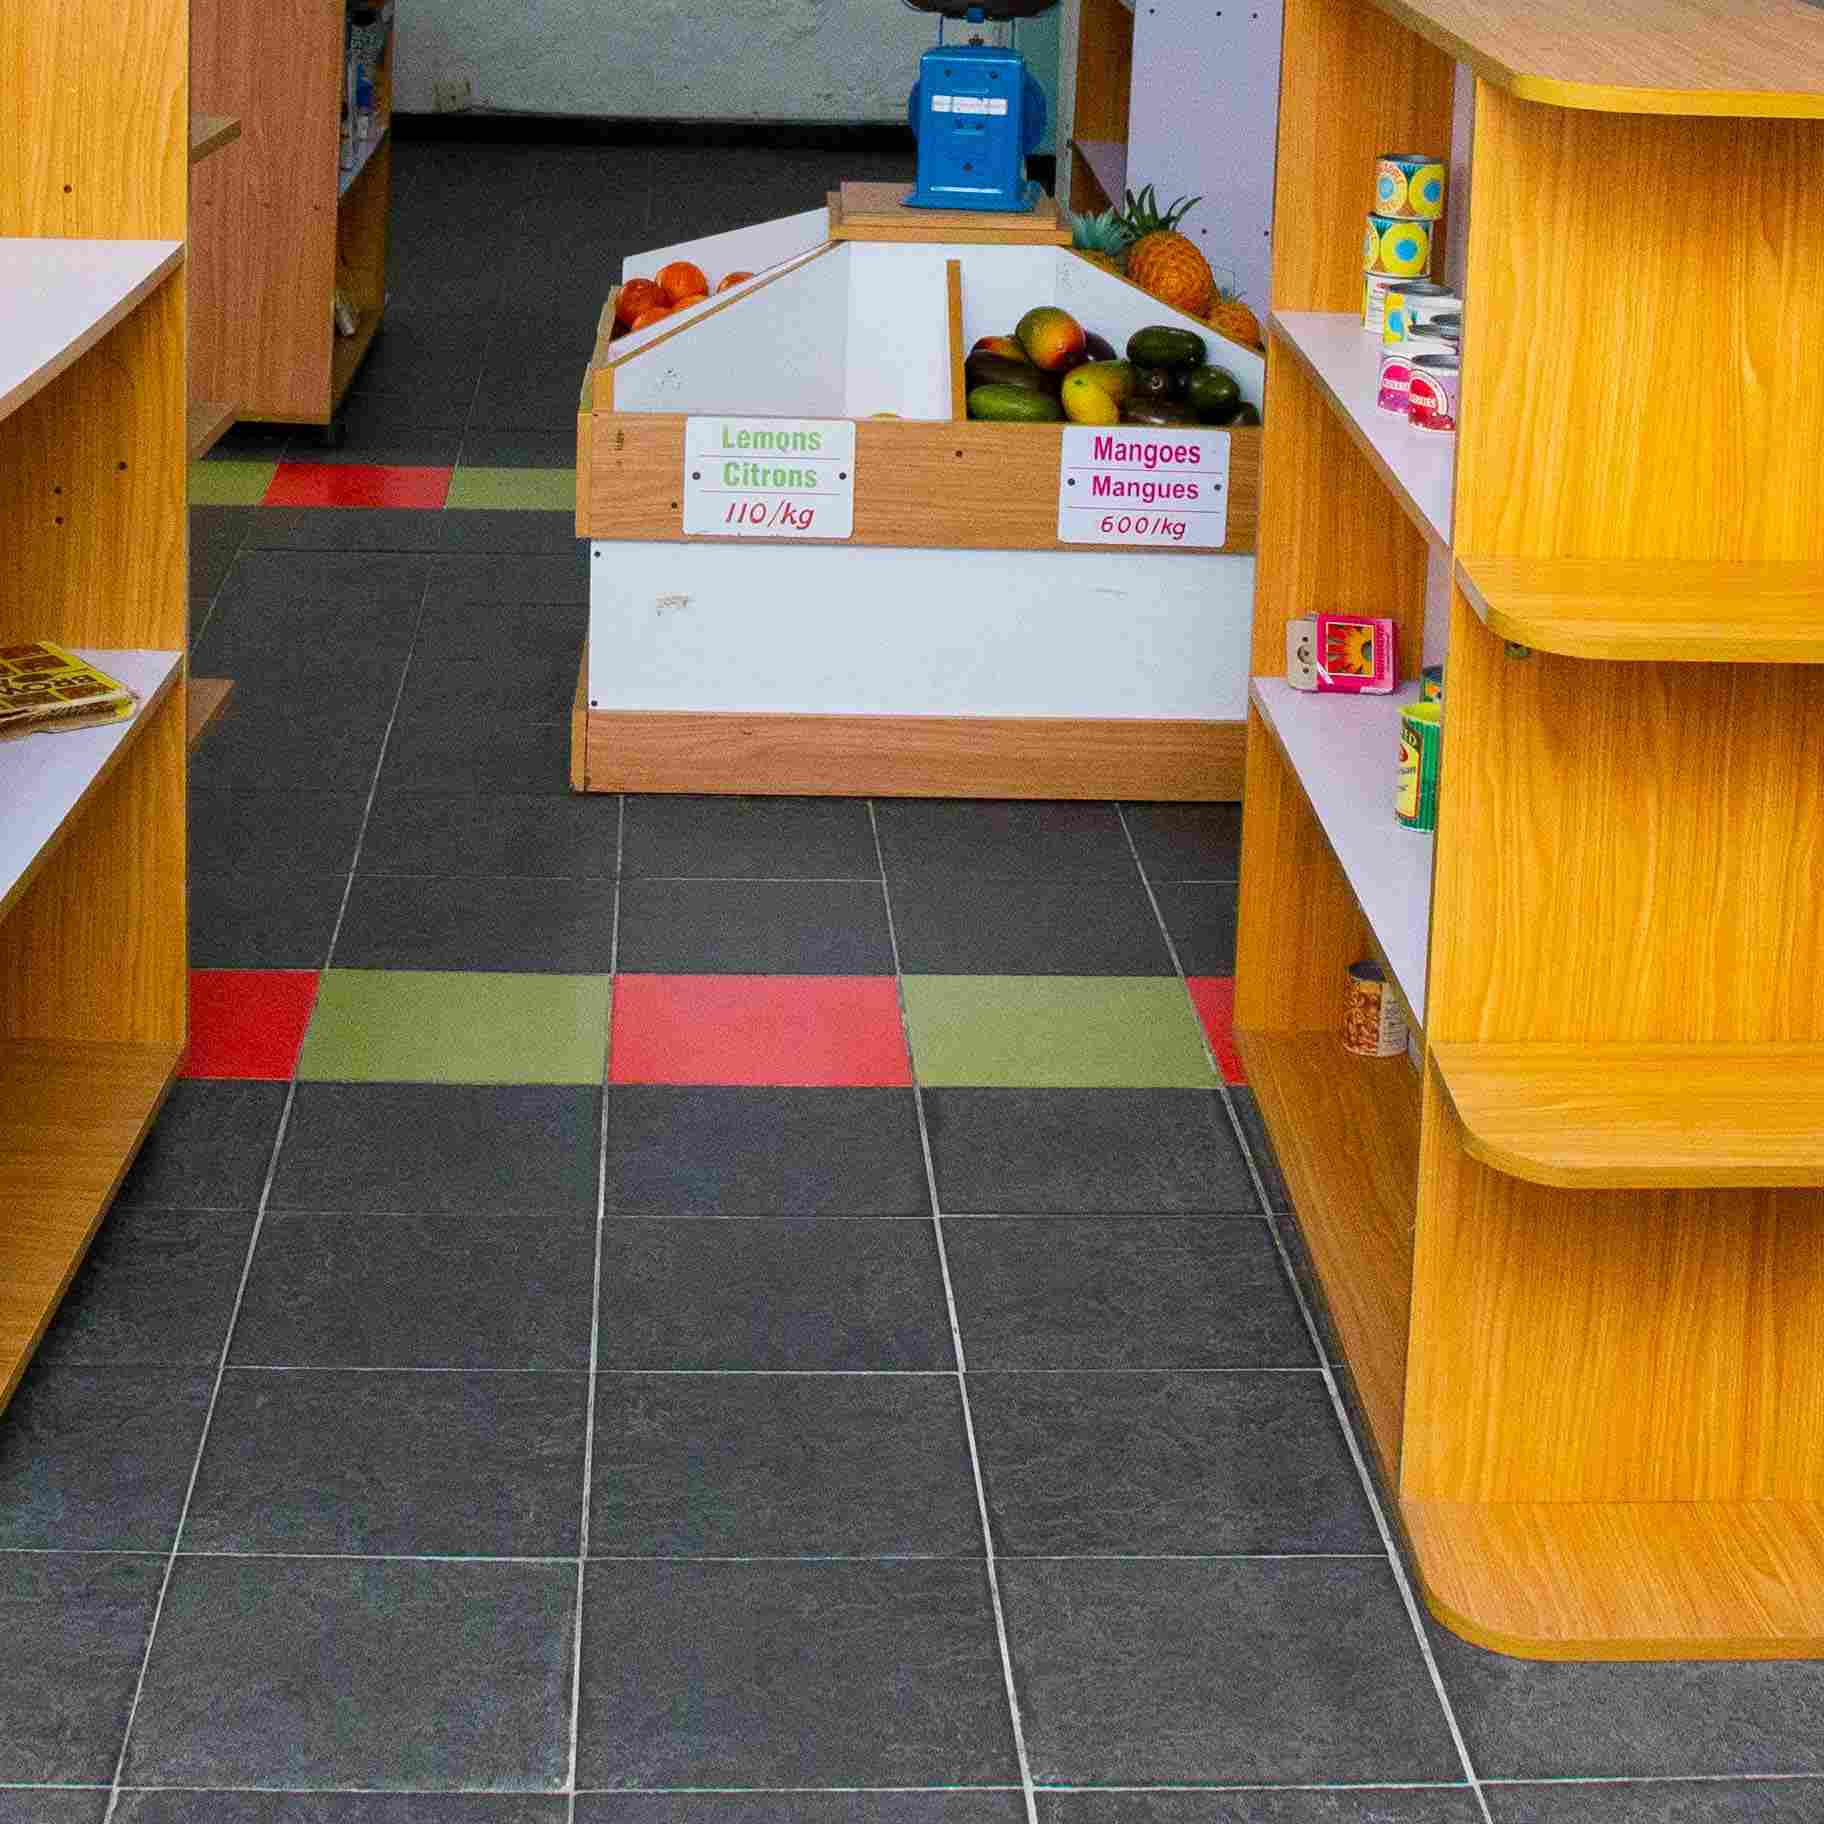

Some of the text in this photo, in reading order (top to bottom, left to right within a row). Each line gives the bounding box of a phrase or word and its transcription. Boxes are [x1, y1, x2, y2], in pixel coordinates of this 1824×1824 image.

[721, 424, 822, 455] Lemons
[1093, 435, 1202, 470] Mangoes
[722, 461, 818, 489] Citrons
[1091, 475, 1200, 505] Mangues
[724, 500, 816, 530] 110/kg
[1099, 514, 1187, 540] 600/kg
